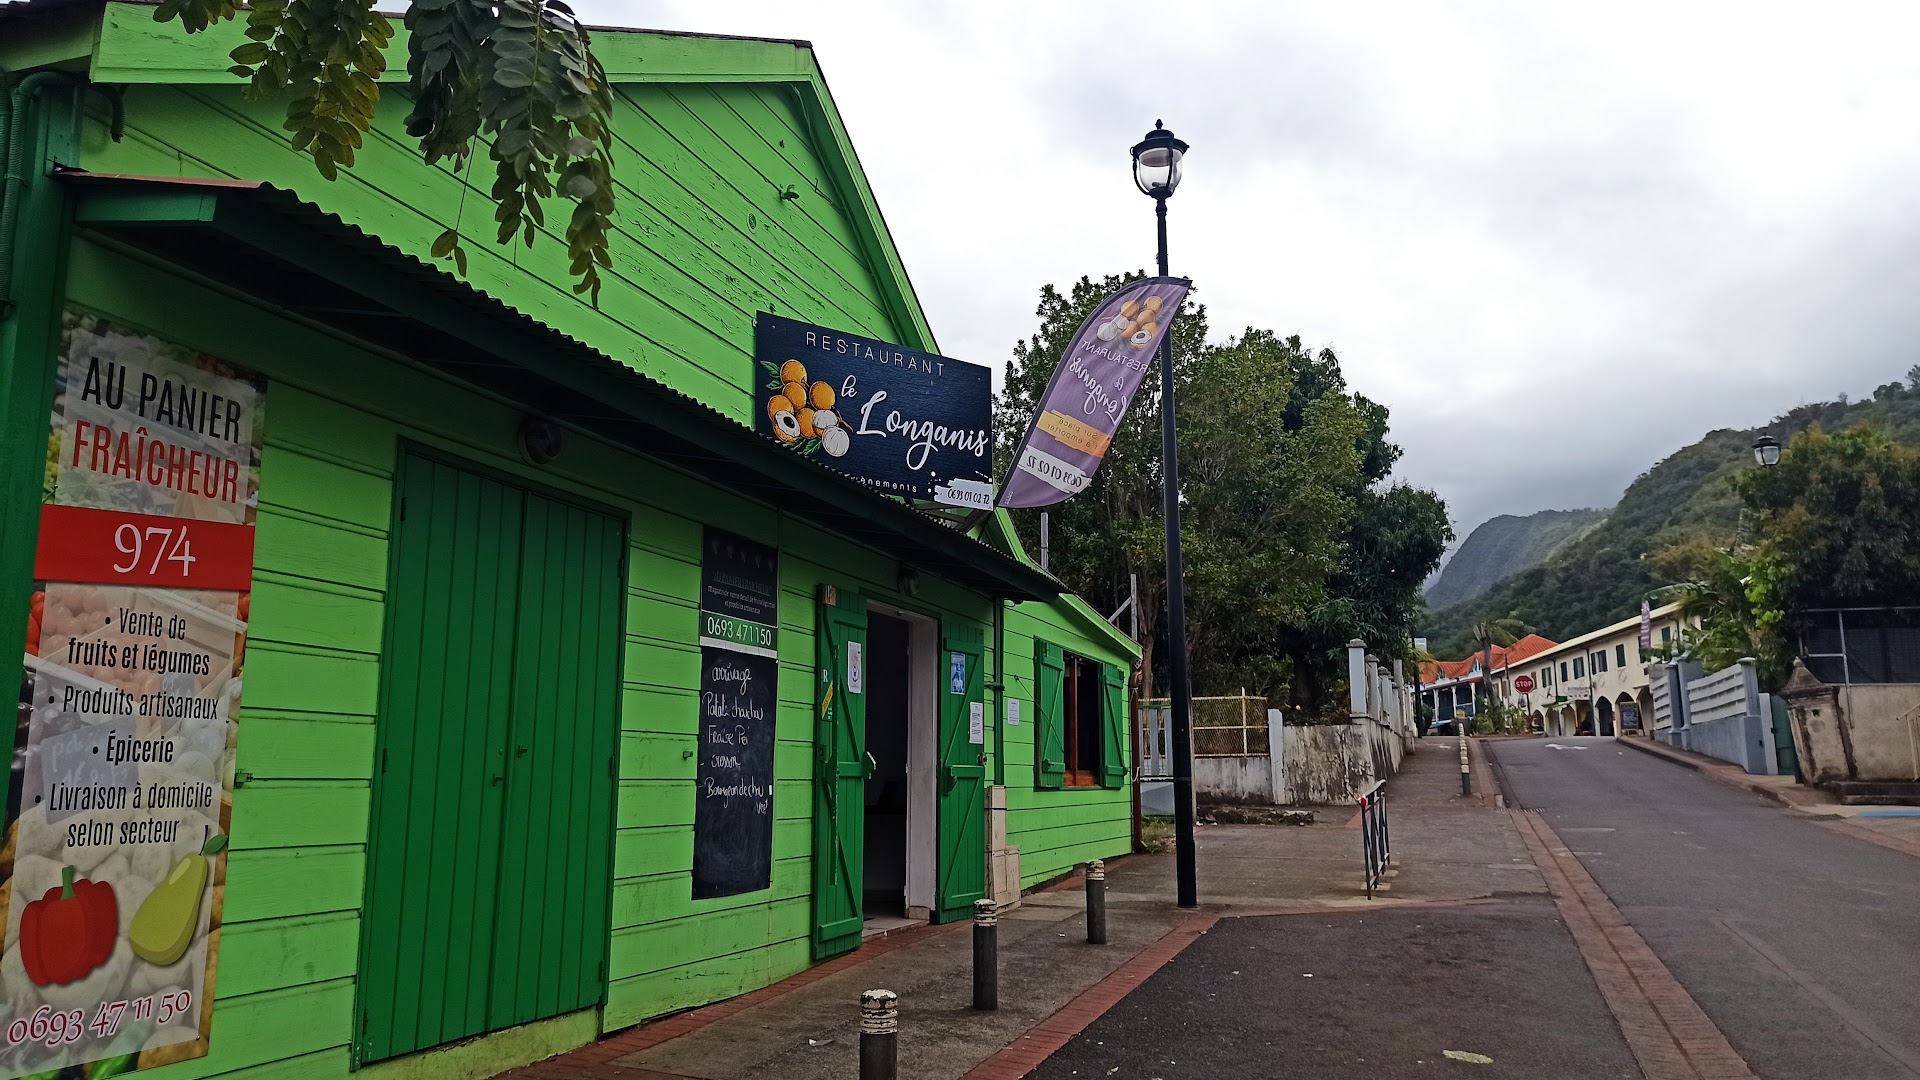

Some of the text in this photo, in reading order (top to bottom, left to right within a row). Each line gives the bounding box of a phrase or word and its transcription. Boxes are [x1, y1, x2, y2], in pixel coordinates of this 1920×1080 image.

[806, 331, 945, 377] RESTAURANT
[81, 357, 242, 444] AU PANIER
[841, 374, 858, 398] le
[857, 390, 989, 470] Longanis
[72, 420, 240, 504] FRAÎCHEUR
[113, 524, 196, 577] 974
[119, 607, 186, 640] Vente de
[707, 617, 734, 639] 0693
[68, 637, 210, 676] fruits et légumes
[711, 662, 753, 696] arrivage
[1515, 680, 1533, 688] STOP
[63, 685, 219, 720] Produits artisanaux
[106, 729, 174, 766] Épicerie
[50, 782, 212, 811] Livraison à domicile
[67, 817, 180, 848] selon secteur
[8, 990, 193, 1048] 0693 47 11 50
